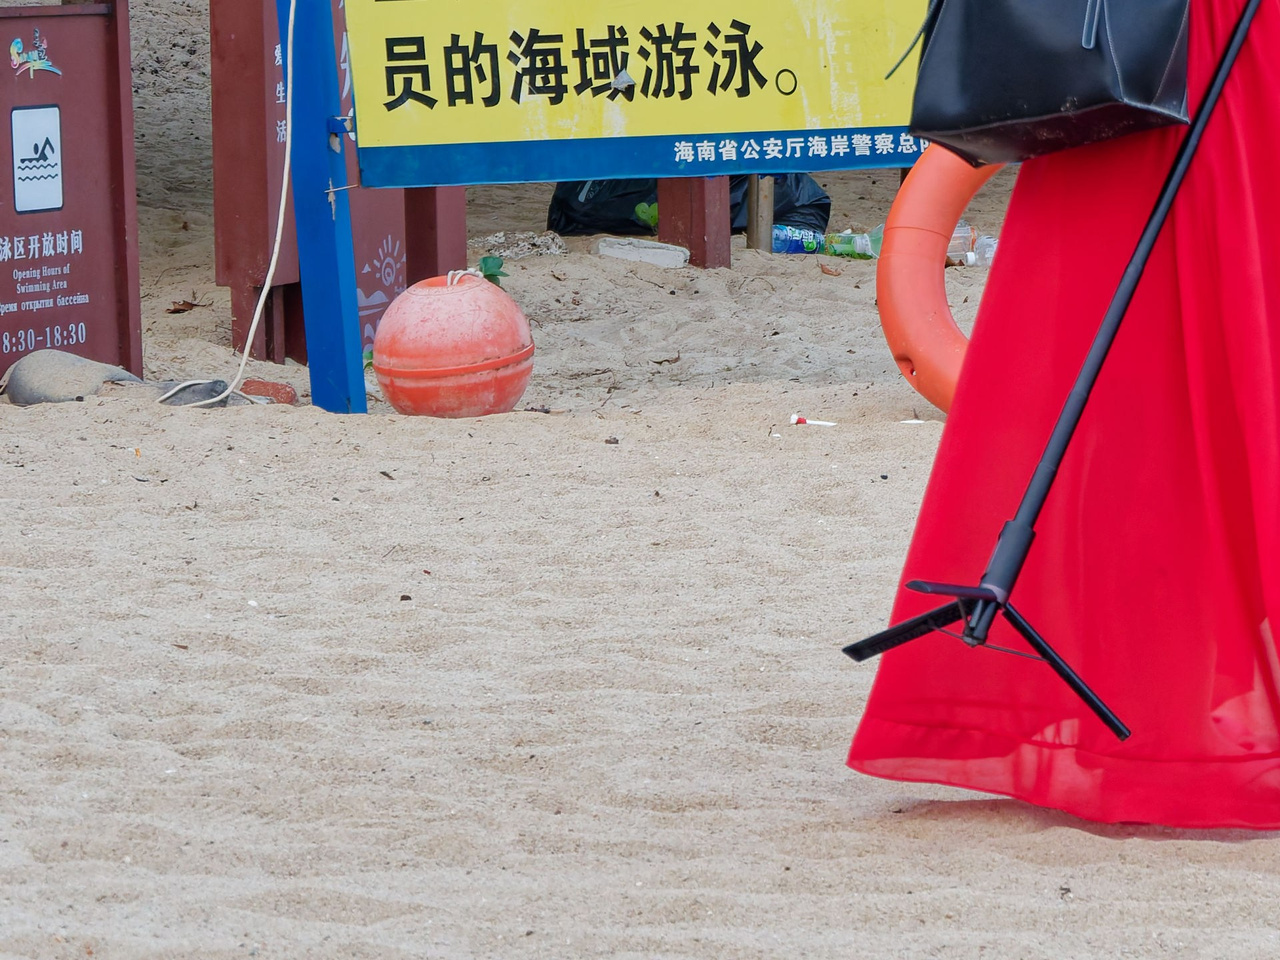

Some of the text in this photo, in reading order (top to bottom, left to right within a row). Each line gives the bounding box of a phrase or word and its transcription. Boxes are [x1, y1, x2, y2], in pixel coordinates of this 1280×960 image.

[382, 20, 799, 113] 员的海域游泳。
[13, 263, 71, 281] Opening Hours of
[16, 279, 68, 294] Swimming Area
[2, 322, 86, 354] 8:30-18:30
